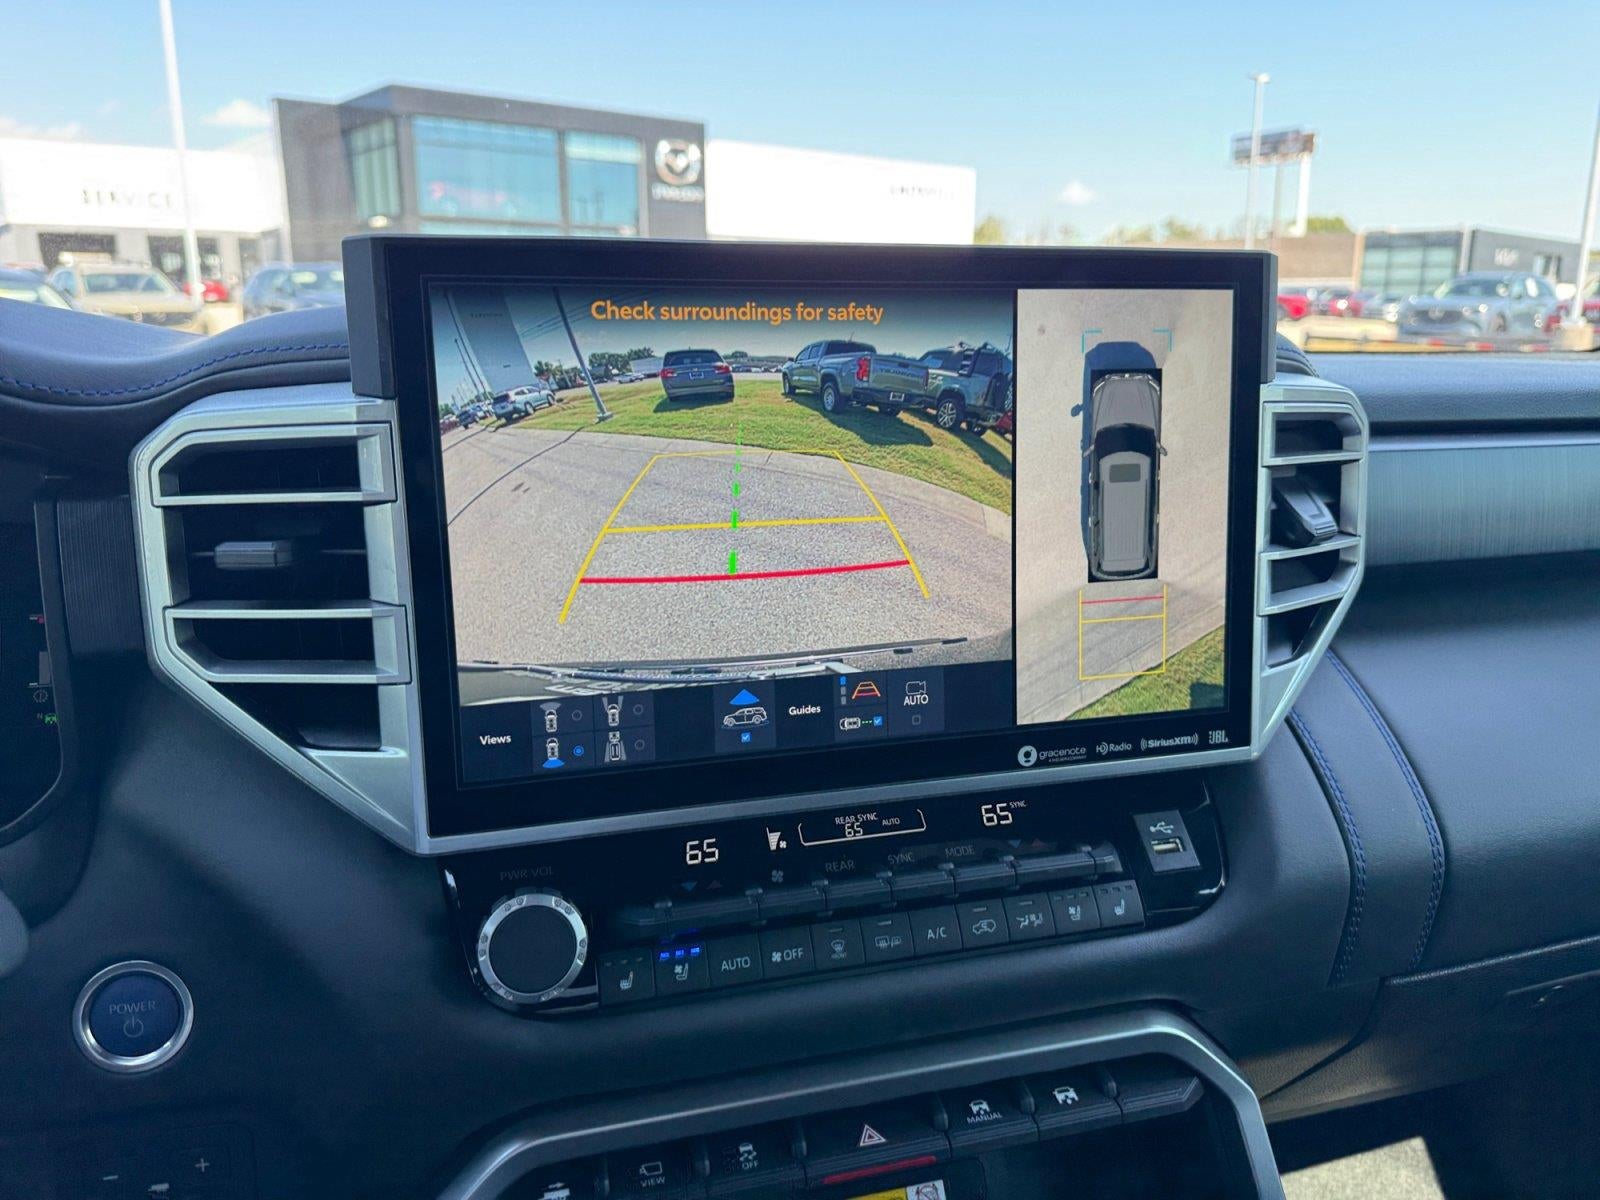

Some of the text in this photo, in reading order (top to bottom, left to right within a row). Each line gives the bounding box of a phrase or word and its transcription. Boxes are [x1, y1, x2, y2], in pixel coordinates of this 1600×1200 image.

[82, 188, 172, 208] SERVCE
[590, 300, 884, 326] Check surroundings for safety
[903, 694, 929, 706] AUTO
[788, 704, 821, 716] Guides
[479, 734, 512, 746] Views
[1208, 730, 1228, 744] JBL
[1039, 746, 1087, 760] gracenote
[1109, 742, 1132, 752] Radio
[1009, 800, 1027, 808] SYNC
[835, 812, 879, 825] REAR SYNC
[882, 817, 900, 826] AUTO
[980, 803, 1013, 827] 65
[845, 822, 864, 838] 65
[685, 838, 719, 865] 65
[945, 845, 975, 857] MODE
[887, 852, 914, 864] SYNC
[825, 860, 855, 873] REAR
[500, 869, 528, 881] PWR
[927, 927, 947, 940] A/C
[783, 947, 804, 961] OFF
[721, 956, 751, 971] AUTO
[108, 1000, 157, 1015] POWER
[966, 1112, 1002, 1124] MANUAL
[742, 1160, 759, 1170] OFF
[640, 1176, 665, 1188] VIEW
